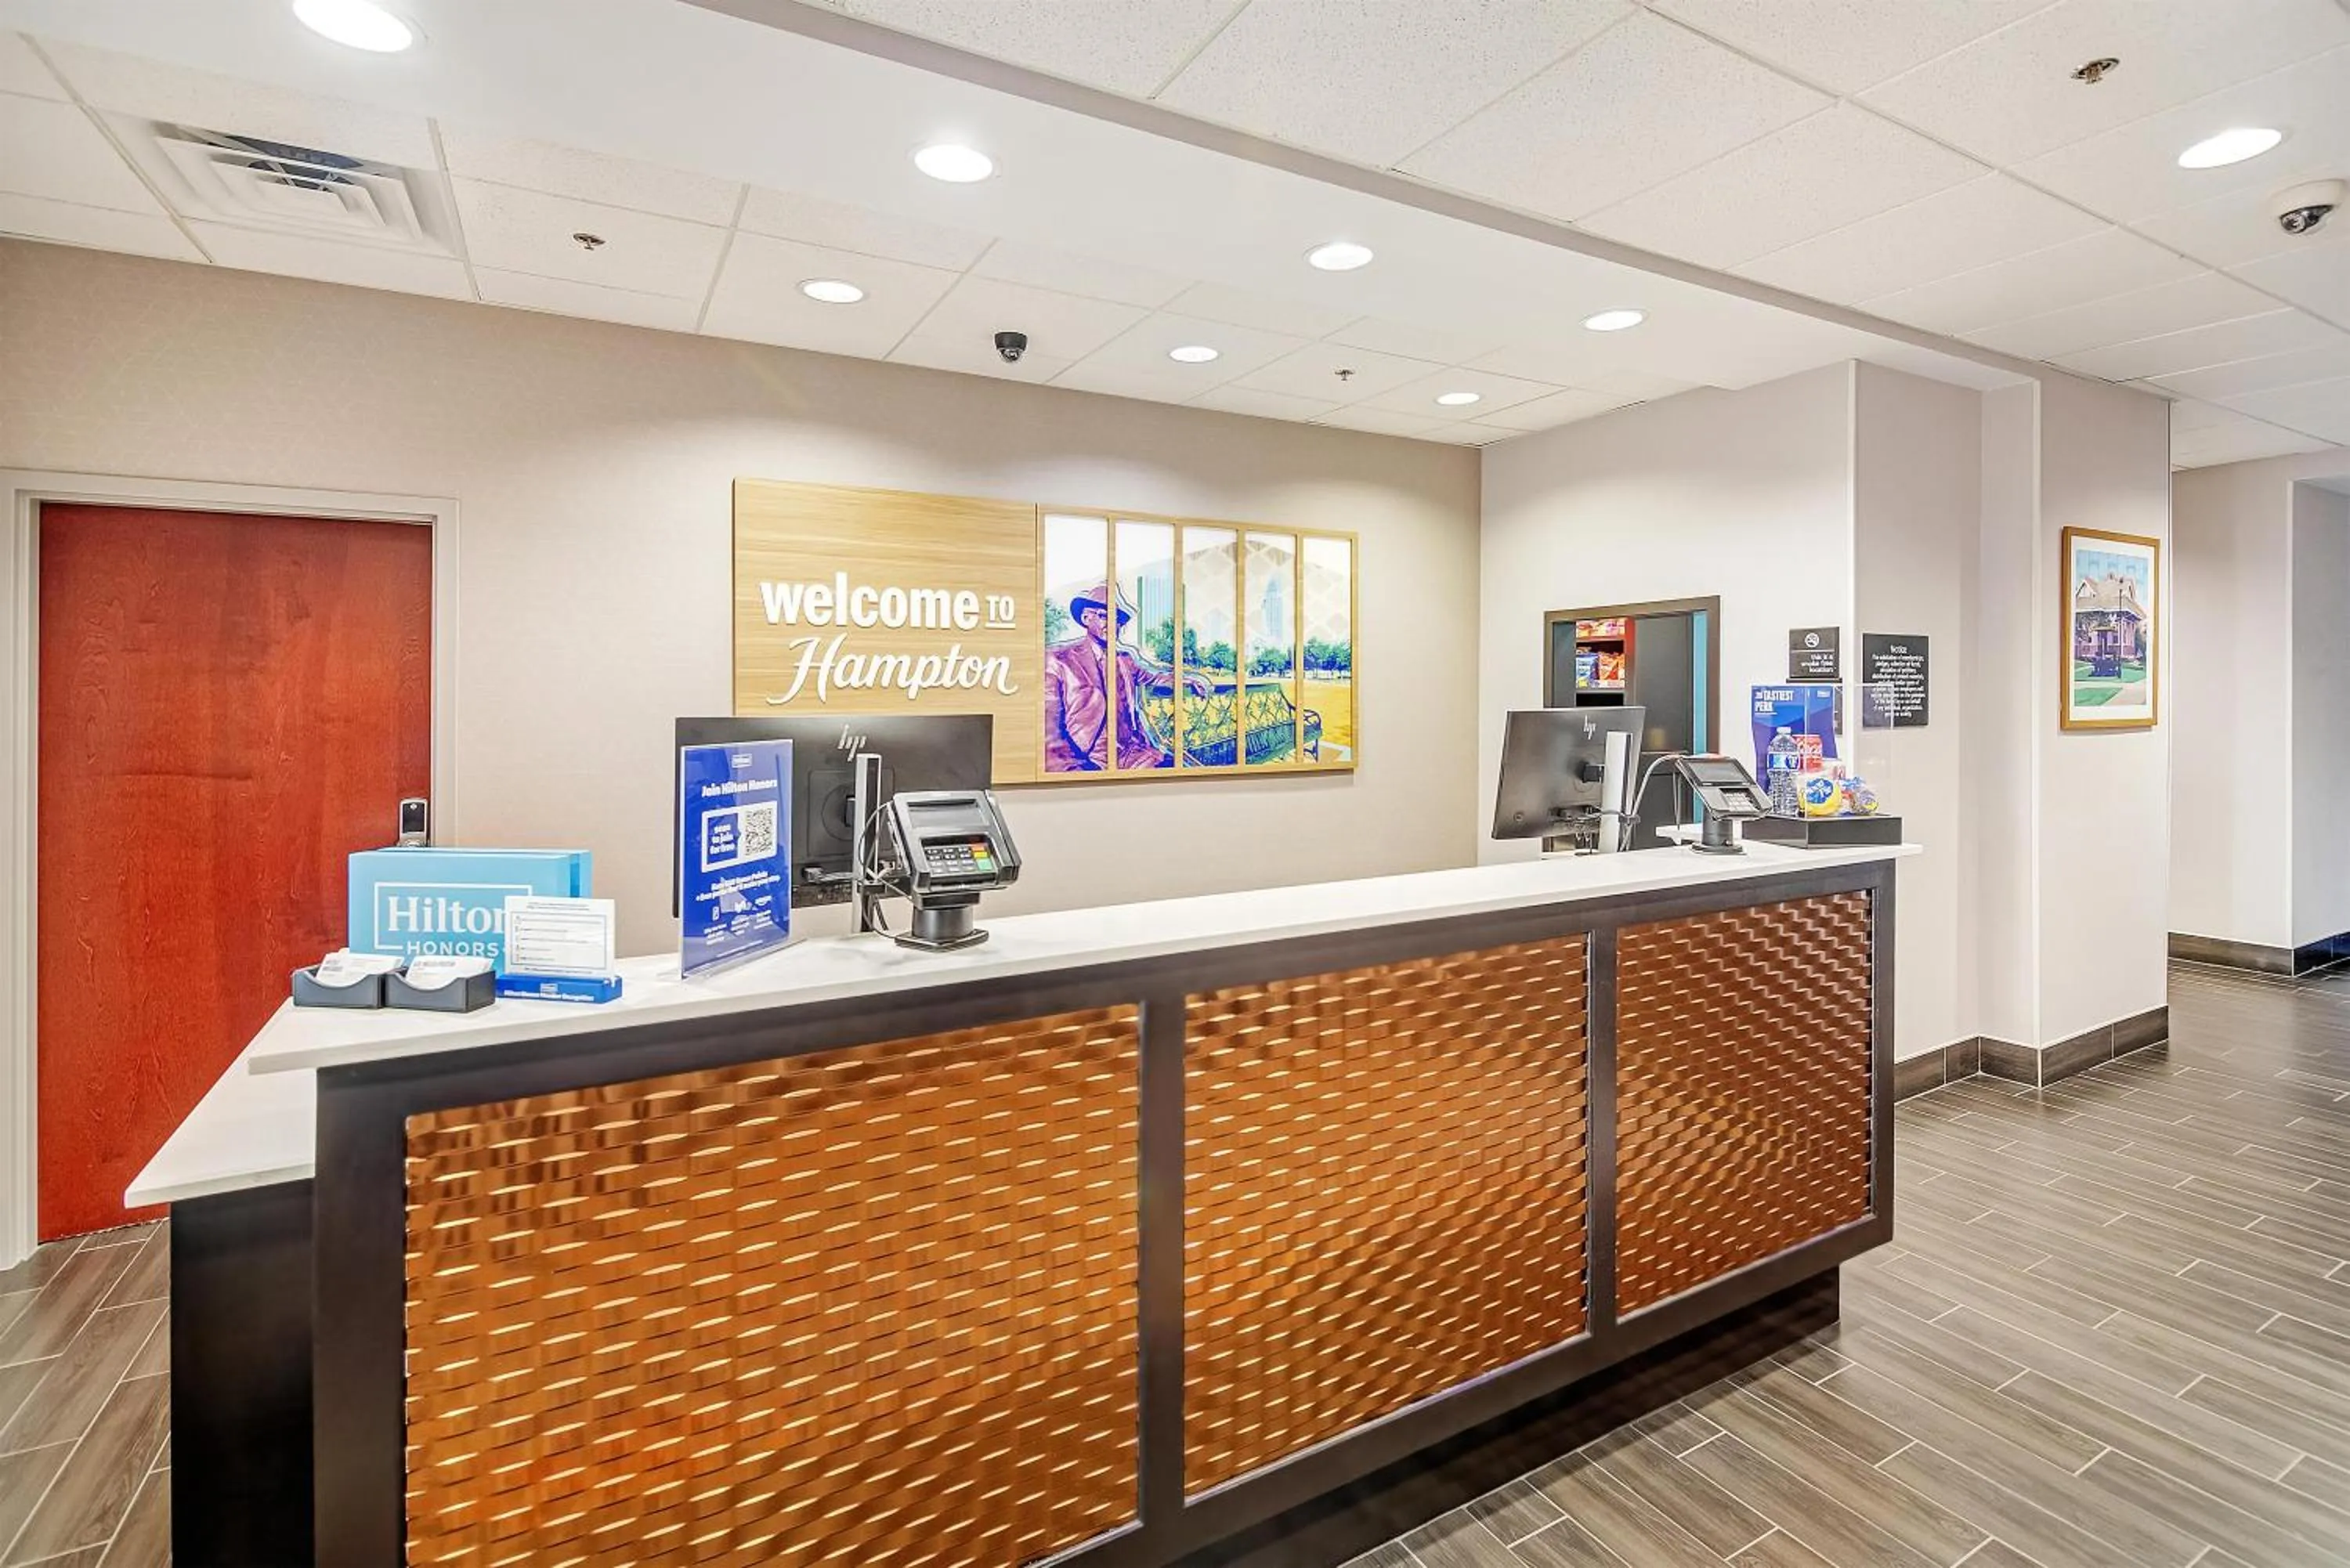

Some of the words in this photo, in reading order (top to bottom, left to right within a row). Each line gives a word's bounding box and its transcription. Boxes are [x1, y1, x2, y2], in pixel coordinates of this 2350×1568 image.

[759, 572, 979, 630] welcome
[766, 632, 1018, 705] Hampton
[837, 724, 867, 762] hp
[701, 782, 721, 798] Join
[721, 781, 748, 795] Hilton
[748, 779, 778, 792] Honors
[407, 940, 499, 957] HONORS
